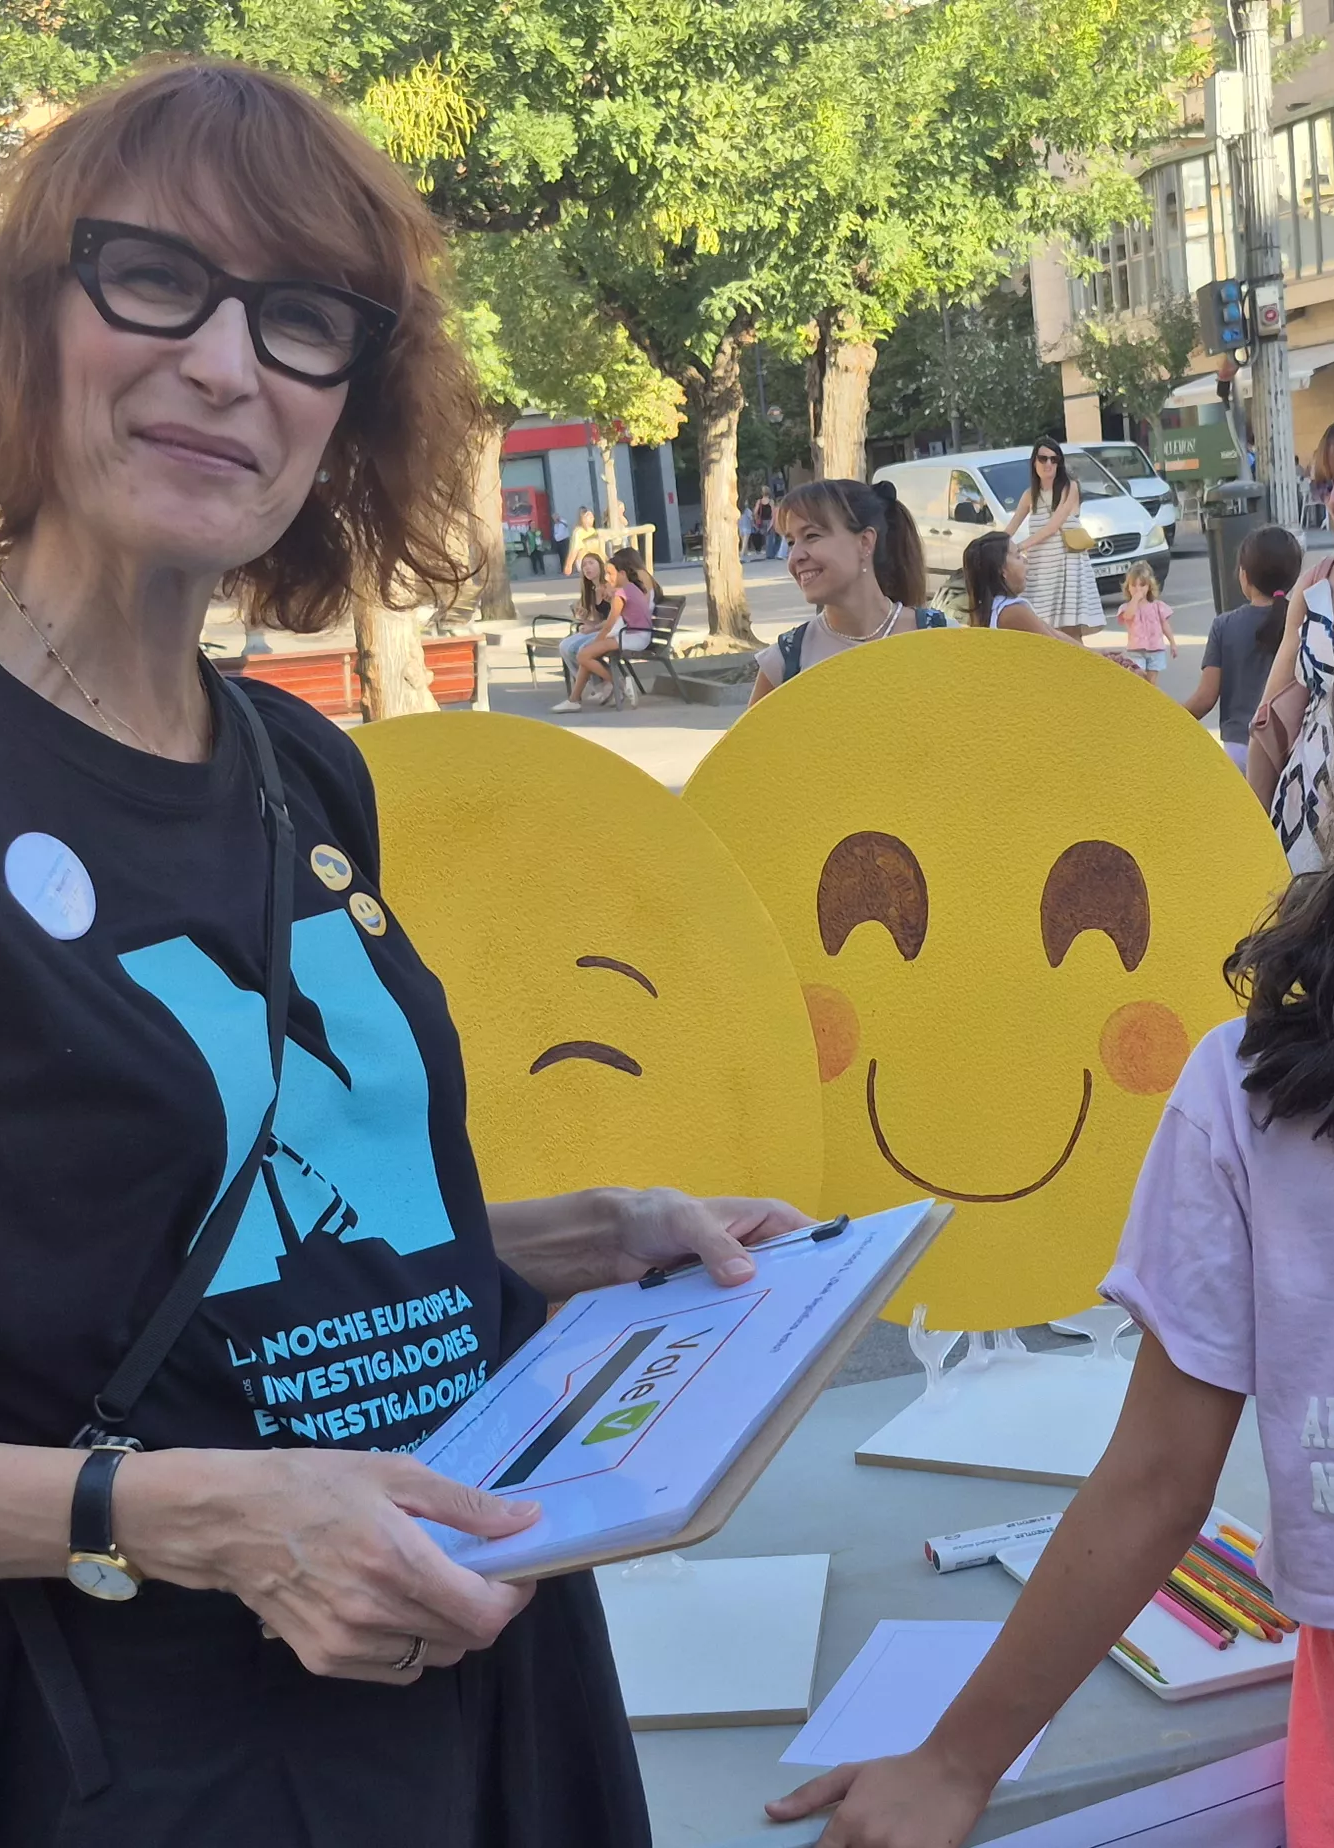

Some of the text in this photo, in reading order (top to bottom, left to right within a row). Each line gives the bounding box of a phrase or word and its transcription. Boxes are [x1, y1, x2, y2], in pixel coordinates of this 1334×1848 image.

[226, 1285, 472, 1368] L NOCHE EUROPEA
[262, 1324, 479, 1406] INVESTIGADORES
[618, 1326, 715, 1403] Vale
[280, 1360, 488, 1441] NVESTIGADORAS
